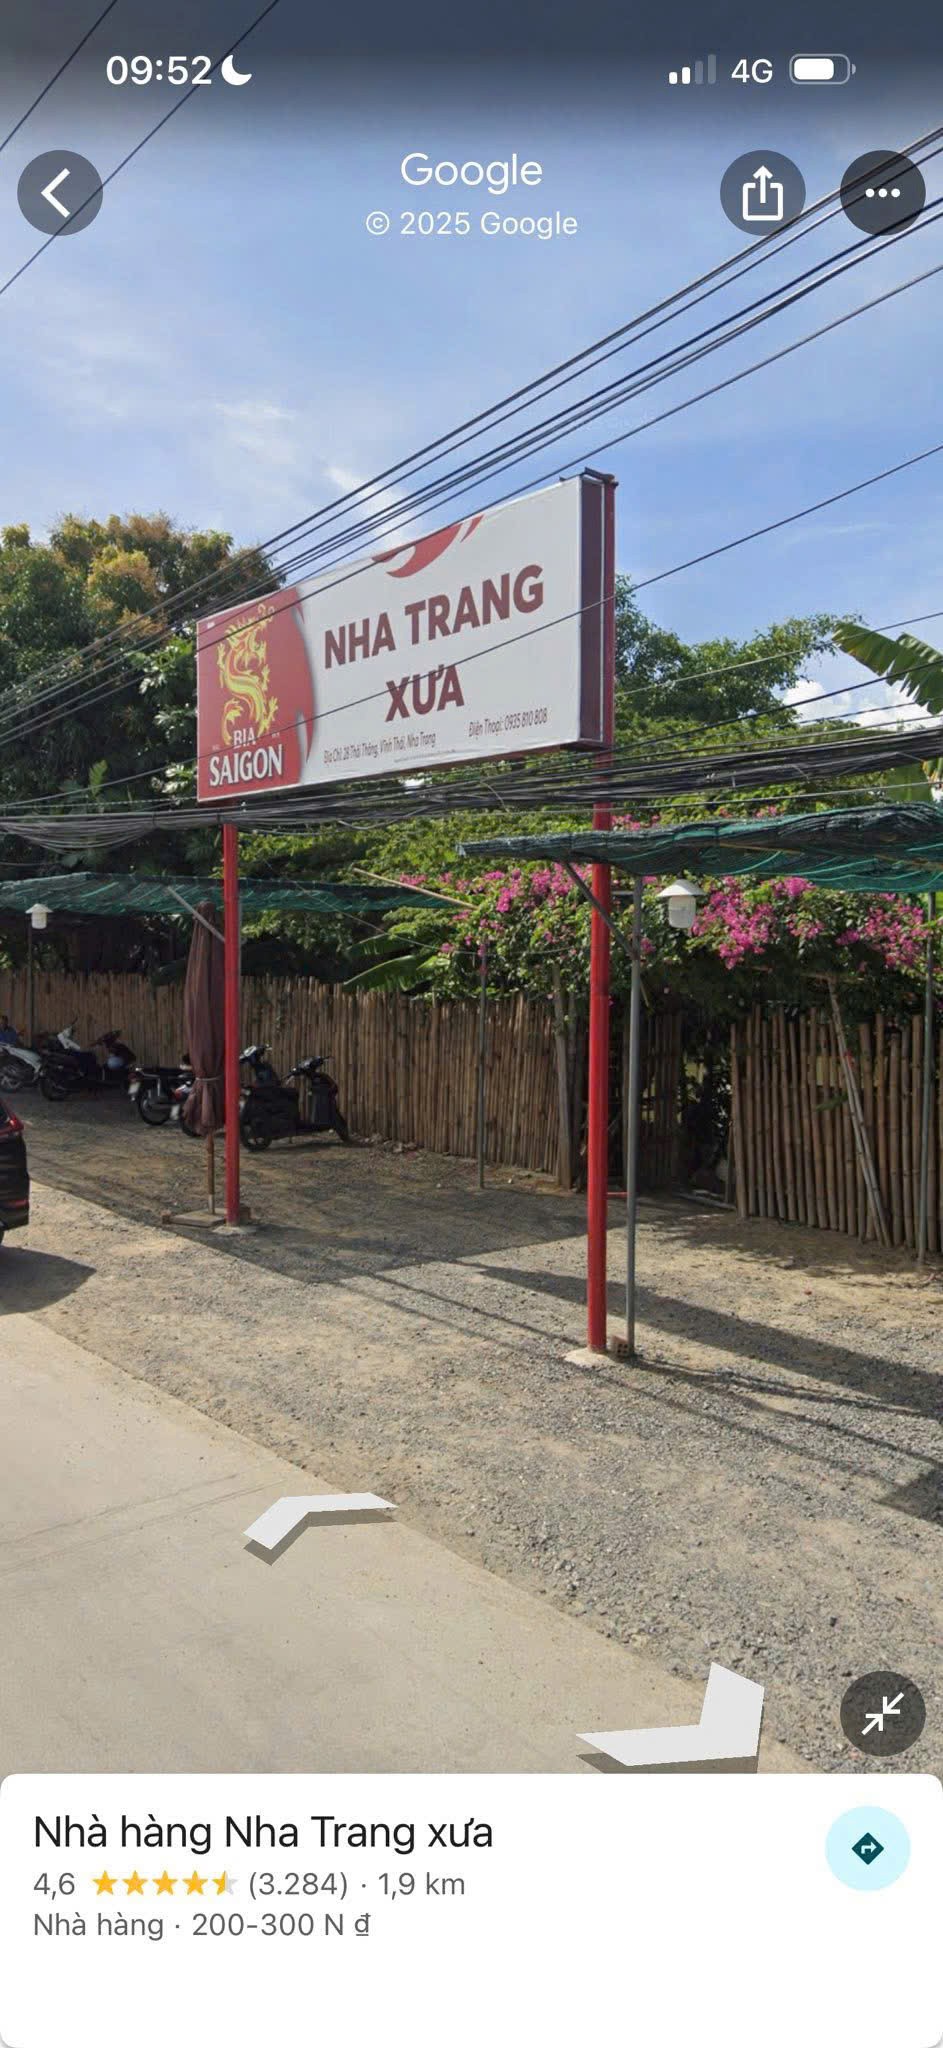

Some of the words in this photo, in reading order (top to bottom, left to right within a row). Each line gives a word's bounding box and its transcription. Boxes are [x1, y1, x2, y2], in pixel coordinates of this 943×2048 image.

[324, 612, 396, 669] NHA
[404, 564, 544, 645] TRANG
[385, 664, 465, 722] XƯA
[233, 727, 257, 749] BIA
[209, 743, 284, 787] SAIGON
